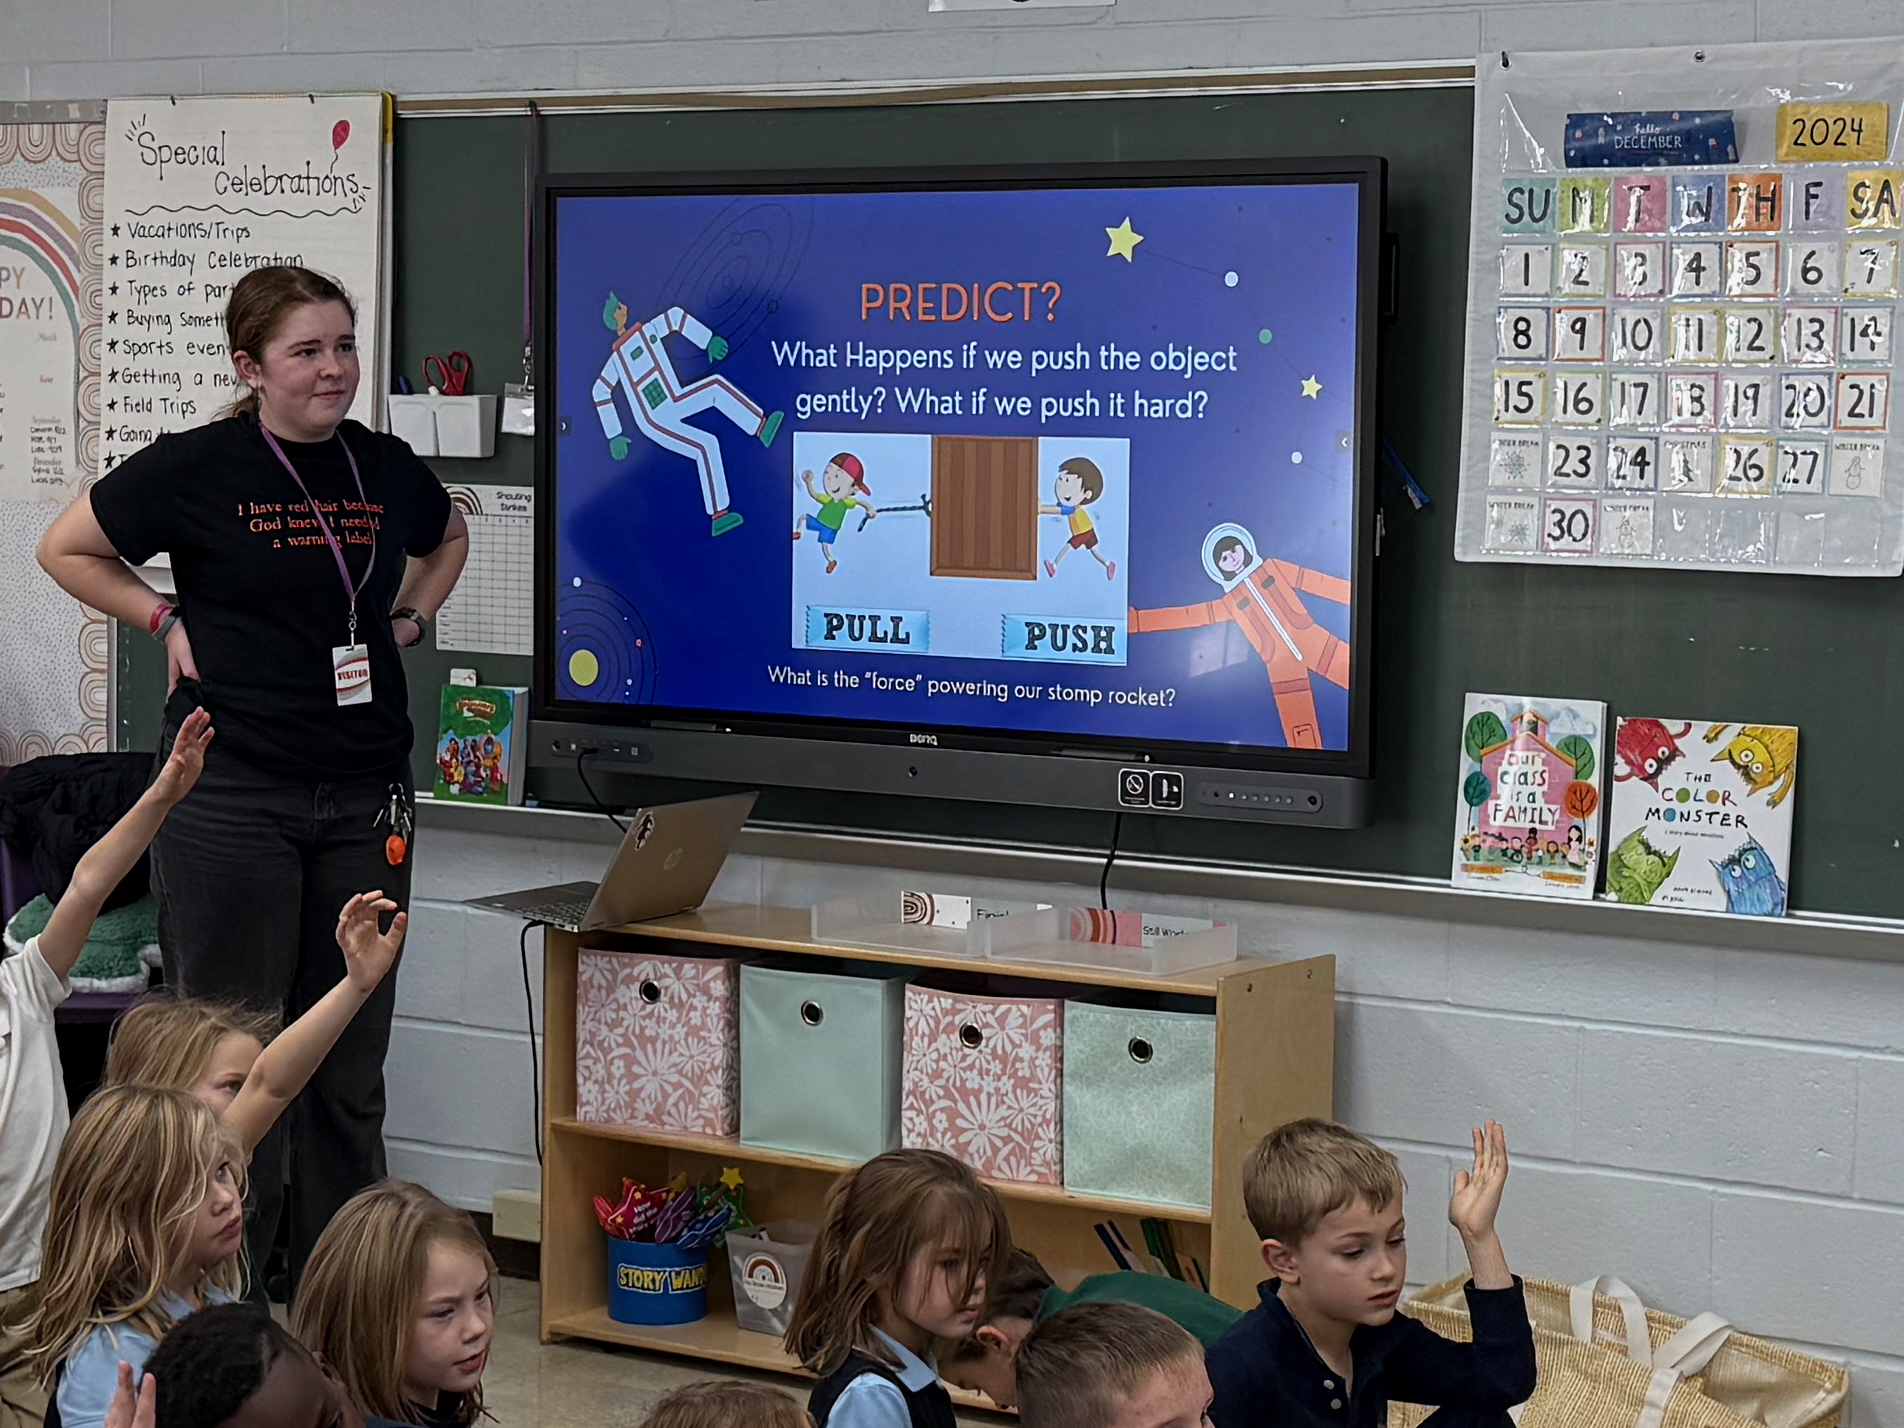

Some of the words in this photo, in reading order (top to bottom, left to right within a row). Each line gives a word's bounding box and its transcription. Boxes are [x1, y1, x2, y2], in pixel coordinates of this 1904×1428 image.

[1614, 135, 1682, 150] DECEMBER
[1792, 117, 1864, 147] 2024
[137, 131, 226, 180] Special
[214, 160, 359, 197] Celebrations
[1505, 187, 1550, 224] SU
[1805, 181, 1824, 221] F
[1850, 180, 1897, 219] SA
[127, 222, 251, 243] Vacations/Trips
[125, 250, 196, 276] Birthday
[208, 251, 303, 268] Celebration
[1523, 253, 1530, 286] 1
[1685, 252, 1706, 286] 4
[1743, 251, 1761, 285] 5
[1801, 250, 1823, 284] 6
[128, 280, 167, 305] Types
[177, 282, 195, 296] of
[861, 282, 1061, 322] PREDICT?
[127, 309, 172, 334] Buying
[1512, 316, 1532, 350] 8
[1570, 317, 1587, 351] 9
[1620, 317, 1653, 351] 10
[1796, 317, 1825, 352] 13
[124, 340, 174, 361] Sports
[771, 341, 837, 369] What
[846, 342, 953, 376] Happens
[961, 342, 977, 370] if
[984, 350, 1022, 370] we
[1031, 342, 1090, 377] push
[1099, 345, 1141, 371] the
[1150, 345, 1237, 379] object
[121, 368, 181, 391] Getting
[194, 373, 202, 385] a
[124, 397, 152, 413] Field
[159, 397, 196, 419] Trips
[796, 386, 886, 420] gently?
[895, 387, 962, 416] What
[971, 388, 986, 417] if
[994, 395, 1032, 417] we
[1040, 390, 1099, 424] push
[1109, 393, 1125, 418] it
[1133, 391, 1208, 420] hard?
[1504, 380, 1533, 412] 15
[1561, 382, 1594, 415] 16
[1618, 382, 1648, 417] 17
[1675, 384, 1705, 417] 18
[1734, 383, 1761, 418] 19
[1785, 383, 1825, 418] 20
[1847, 382, 1875, 418] 21
[1553, 444, 1592, 478] 23
[1614, 446, 1651, 481] 24
[1729, 447, 1764, 482] 26
[1782, 450, 1818, 484] 27
[238, 504, 243, 516] I
[250, 502, 282, 514] have
[288, 500, 308, 512] red
[315, 500, 338, 511] hair
[250, 517, 281, 532] God
[330, 516, 334, 527] I
[1547, 508, 1589, 542] 30
[273, 539, 281, 548] a
[823, 613, 910, 645] PULL
[1025, 622, 1115, 655] PUSH
[768, 666, 811, 686] What
[817, 672, 828, 687] is
[833, 671, 859, 688] the
[928, 679, 1008, 702] powering
[1014, 685, 1042, 700] our
[1048, 686, 1102, 707] stomp
[1108, 688, 1176, 708] rocket?
[1685, 772, 1711, 782] THE
[1511, 792, 1519, 802] is
[1527, 791, 1536, 803] a
[1662, 787, 1737, 807] COLOR
[1494, 803, 1559, 826] FAMILY
[1645, 807, 1748, 829] MONSTER
[619, 1268, 664, 1289] STORY
